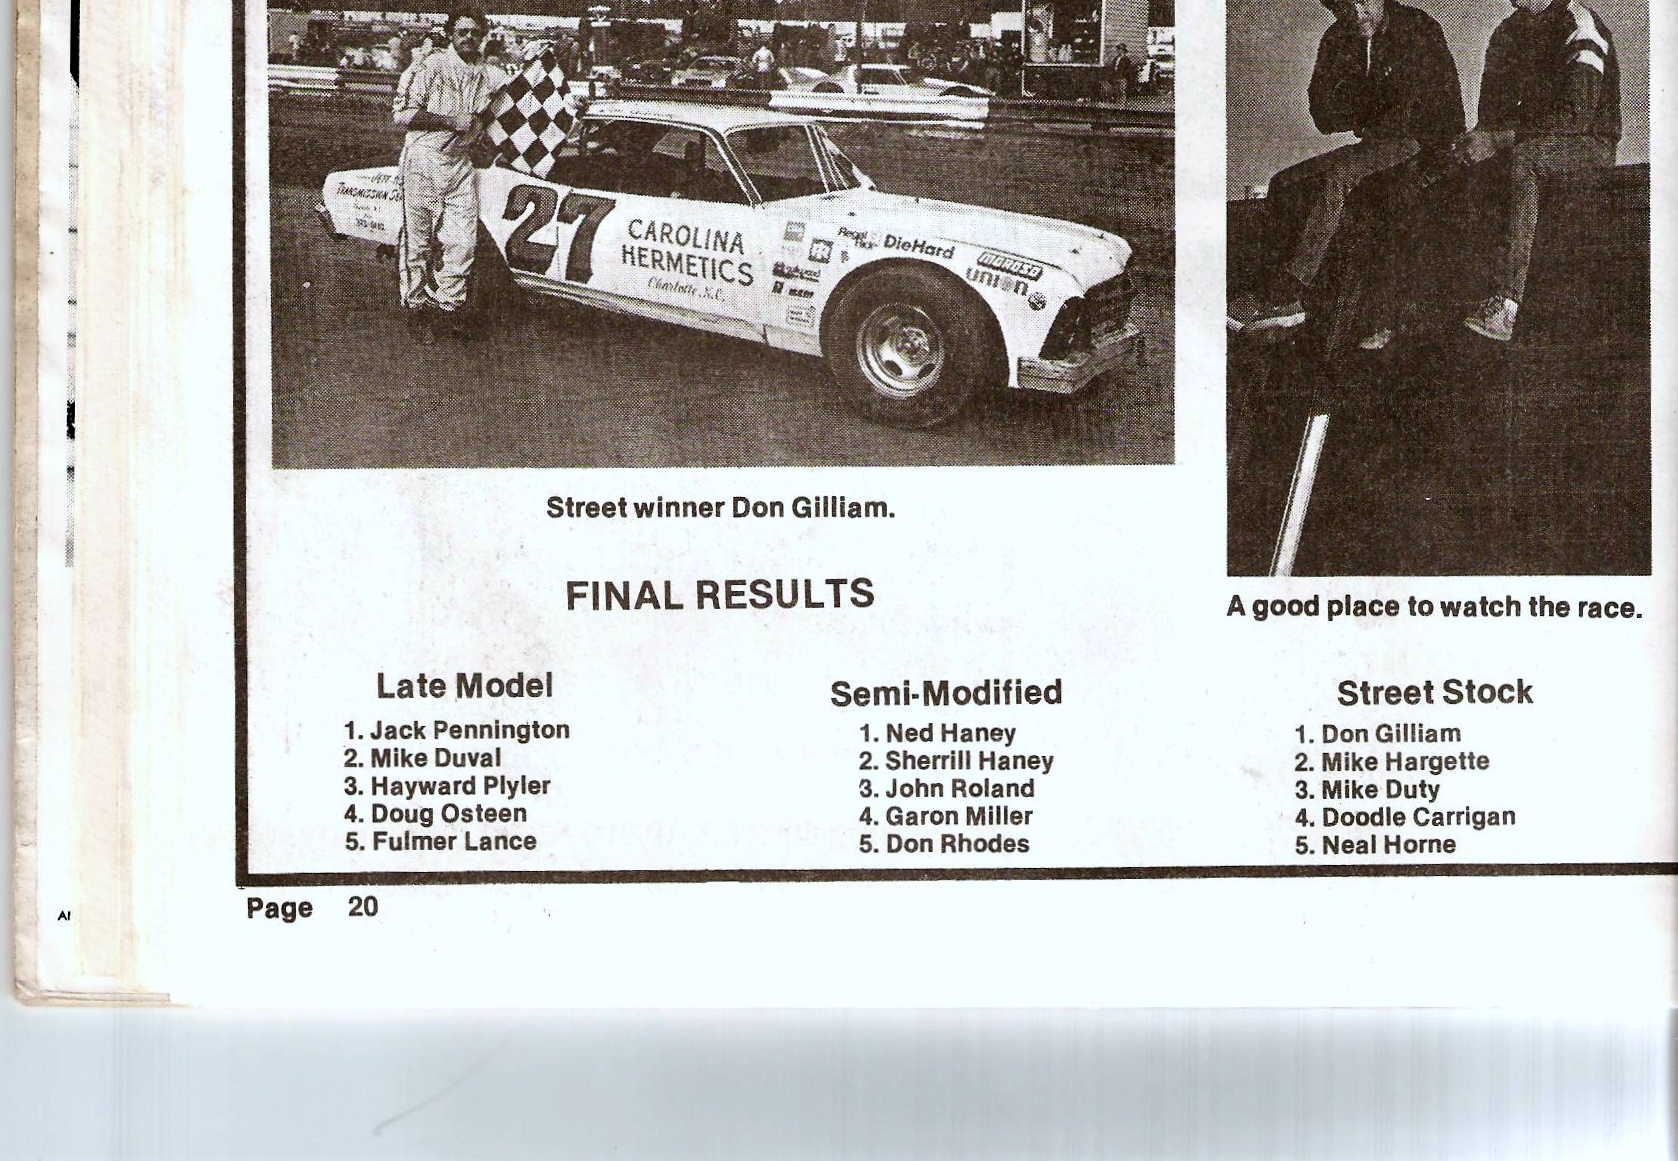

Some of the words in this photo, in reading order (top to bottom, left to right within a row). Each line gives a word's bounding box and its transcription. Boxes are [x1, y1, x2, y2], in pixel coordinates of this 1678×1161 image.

[502, 183, 617, 284] 27
[627, 218, 745, 255] CAROLINA
[883, 233, 956, 260] DieHard
[621, 243, 755, 287] HERMETICS
[546, 495, 628, 519] Street
[633, 495, 726, 519] winner
[732, 496, 784, 518] Don
[791, 495, 895, 519] Gilliam.
[566, 580, 684, 611] FINAL
[696, 577, 875, 610] RESULTS
[1226, 594, 1246, 617] A
[1252, 594, 1320, 622] good
[1327, 593, 1400, 622] place
[1407, 595, 1434, 617] to
[1439, 594, 1521, 618] watch
[1528, 595, 1571, 618] the
[1578, 600, 1643, 619] race.
[377, 672, 447, 699] Late
[456, 671, 553, 699] Model
[830, 678, 1062, 708] Semi-Modified
[1337, 679, 1434, 707] Street
[1442, 678, 1534, 705] Stock
[344, 720, 364, 740] 1.
[370, 720, 427, 741] Jack
[434, 719, 570, 745] Pennington
[859, 723, 879, 743] 1.
[886, 722, 934, 743] Ned
[941, 722, 1017, 748] Haney
[1295, 724, 1315, 744] 1.
[1322, 724, 1369, 744] Don
[1375, 722, 1462, 744] Gilliam
[344, 748, 364, 768] 2.
[371, 747, 428, 768] Mike
[435, 746, 501, 768] Duval
[859, 750, 879, 771] 2.
[885, 749, 971, 771] Sherrill
[979, 750, 1054, 775] Haney
[1294, 752, 1315, 772] 2.
[1322, 751, 1379, 772] Mike
[1385, 751, 1490, 776] Hargette
[344, 775, 364, 796] 3.
[371, 775, 476, 801] Hayward
[483, 774, 552, 800] Plyler
[858, 778, 879, 798] 3.
[885, 777, 944, 799] John
[951, 777, 1035, 799] Roland
[1295, 779, 1315, 800] 3.
[1322, 779, 1379, 800] Mike
[1386, 778, 1441, 804] Duty
[344, 803, 364, 823] 4.
[372, 803, 434, 828] Doug
[441, 802, 527, 824] Osteen
[859, 806, 879, 826] 4.
[886, 805, 959, 827] Garon
[966, 805, 1034, 826] Miller
[1295, 807, 1315, 828] 4.
[1322, 806, 1407, 828] Doodle
[1413, 805, 1516, 831] Carrigan
[345, 831, 365, 851] 5.
[373, 830, 458, 852] Fulmer
[465, 830, 537, 852] Lance
[859, 833, 879, 854] 5.
[887, 833, 934, 854] Don
[941, 832, 1030, 854] Rhodes
[1295, 835, 1315, 856] 5.
[1322, 834, 1377, 855] Neal
[1384, 834, 1457, 855] Horne
[247, 896, 314, 924] Page
[348, 895, 379, 917] 20
